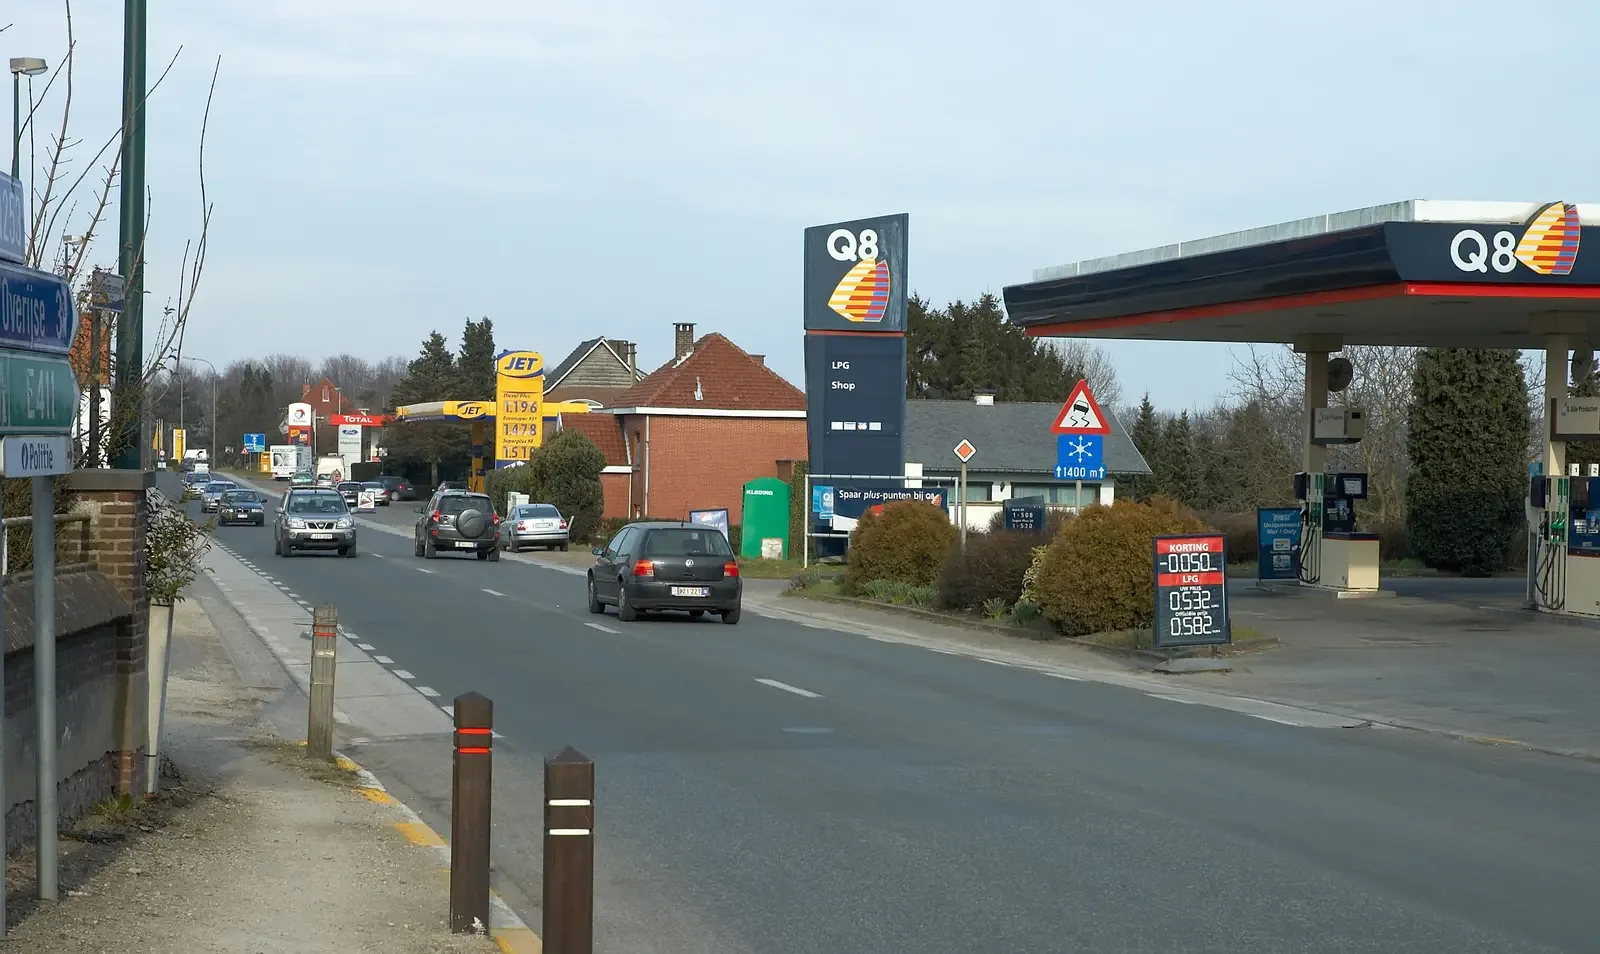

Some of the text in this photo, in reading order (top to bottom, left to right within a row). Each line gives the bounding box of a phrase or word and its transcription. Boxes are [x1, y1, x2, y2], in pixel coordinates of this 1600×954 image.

[827, 229, 879, 262] Q8
[1450, 229, 1517, 273] Q8
[504, 357, 538, 371] JET
[832, 361, 850, 370] LPG
[831, 381, 856, 391] Shop
[27, 369, 55, 420] E411
[462, 406, 482, 415] JET
[503, 401, 537, 413] 1.196
[343, 415, 372, 423] TOTAL
[503, 424, 537, 436] 1.478
[30, 443, 53, 470] Politie
[1063, 467, 1098, 478] 1400 m
[839, 490, 862, 499] Spaar
[863, 490, 911, 500] plus-punten
[913, 491, 924, 501] bij
[1169, 543, 1209, 553] KORTING
[1160, 553, 1210, 573] -0.050
[1182, 575, 1199, 583] LPG
[1170, 591, 1211, 611] 0.532
[1171, 616, 1212, 636] 0.582
